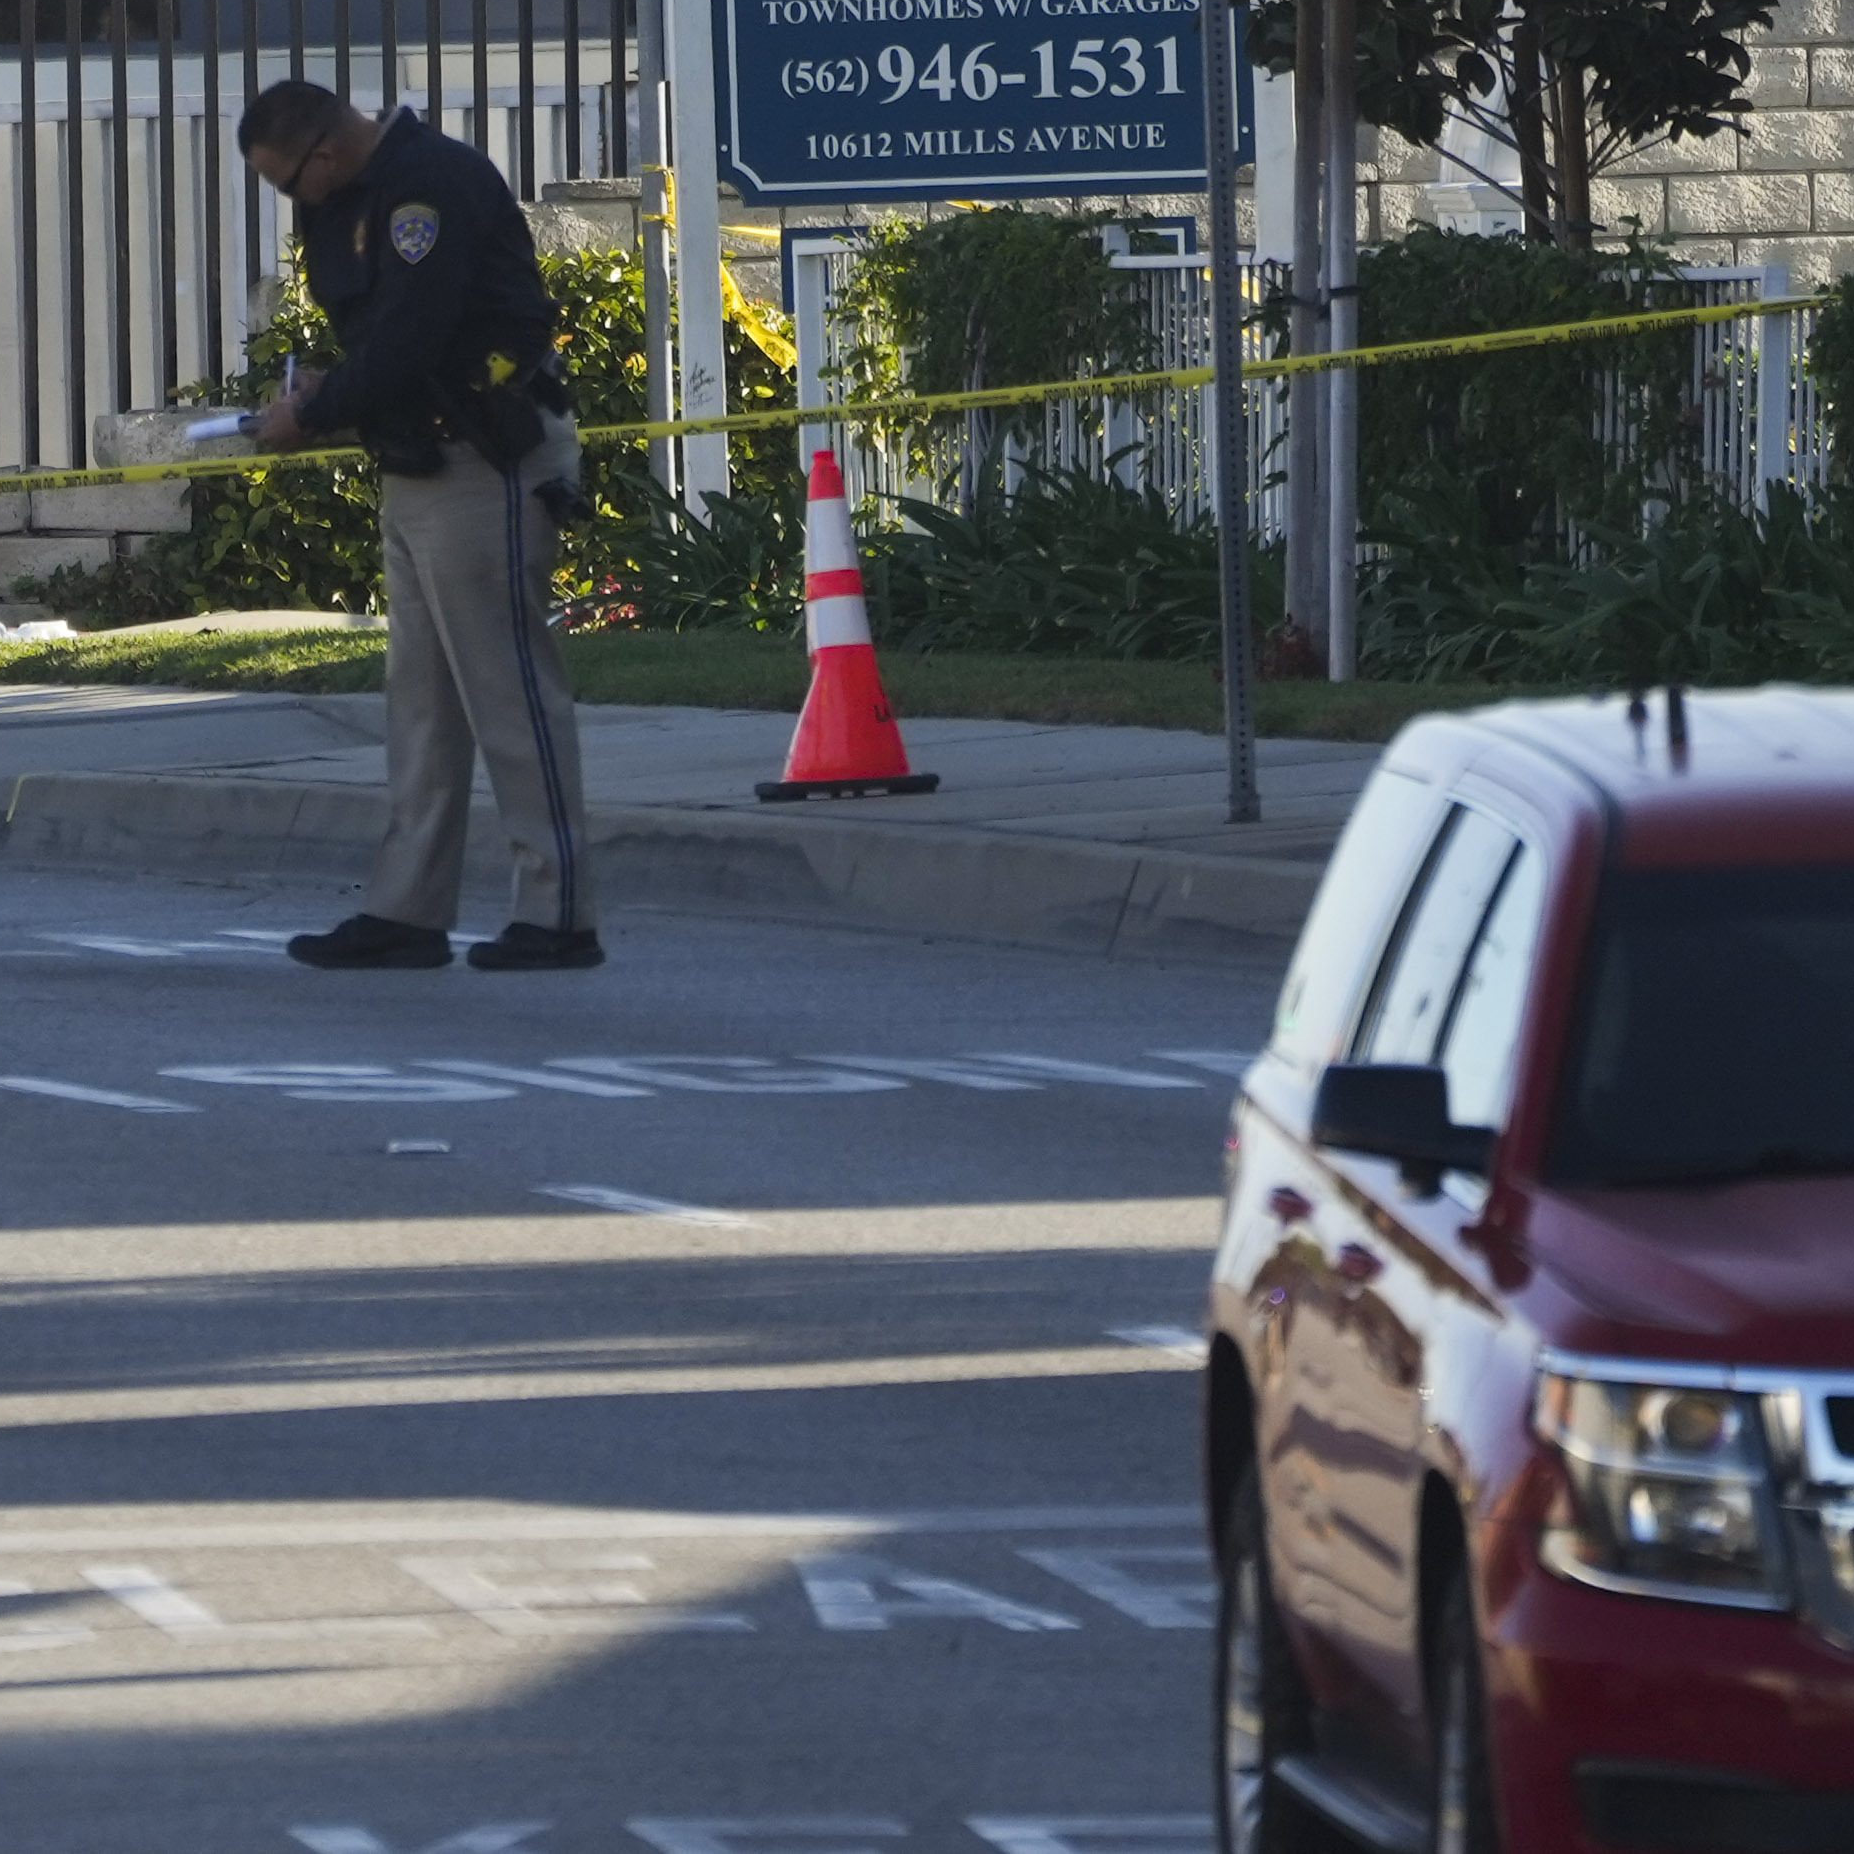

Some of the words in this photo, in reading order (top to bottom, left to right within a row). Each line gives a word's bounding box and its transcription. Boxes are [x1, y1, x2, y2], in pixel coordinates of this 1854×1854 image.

[781, 56, 870, 100] (562)
[877, 35, 1186, 105] 946-1531
[806, 132, 893, 160] 10612
[903, 127, 1016, 157] MILLS
[1024, 123, 1166, 153] AVENUE
